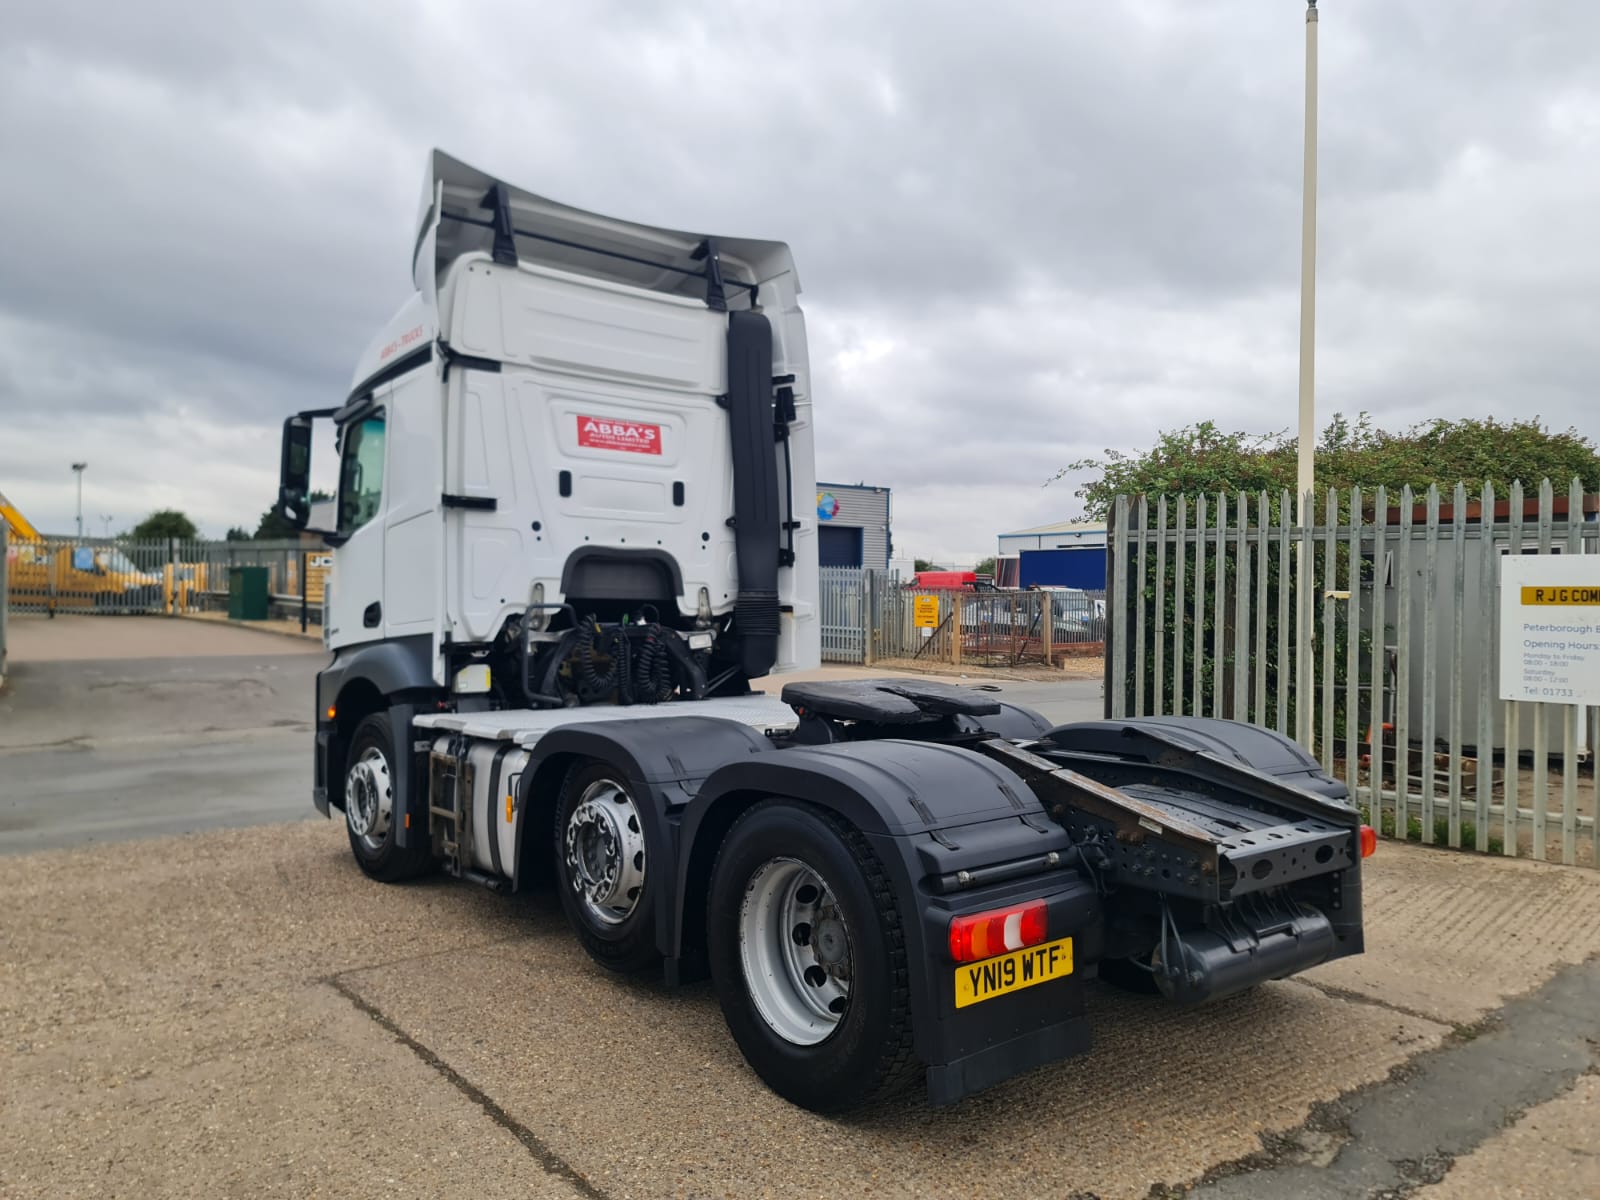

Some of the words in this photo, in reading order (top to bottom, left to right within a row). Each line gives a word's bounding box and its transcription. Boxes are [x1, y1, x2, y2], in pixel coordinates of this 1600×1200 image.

[583, 422, 656, 440] ABBA'S
[1572, 589, 1600, 602] COM
[1523, 624, 1592, 635] Peterborough
[1523, 640, 1566, 651] Opening
[1523, 652, 1551, 660] Monday
[1523, 668, 1556, 676] Saturday
[1542, 687, 1574, 698] 01733
[969, 957, 1016, 997] YN19
[1022, 945, 1060, 982] WTF
